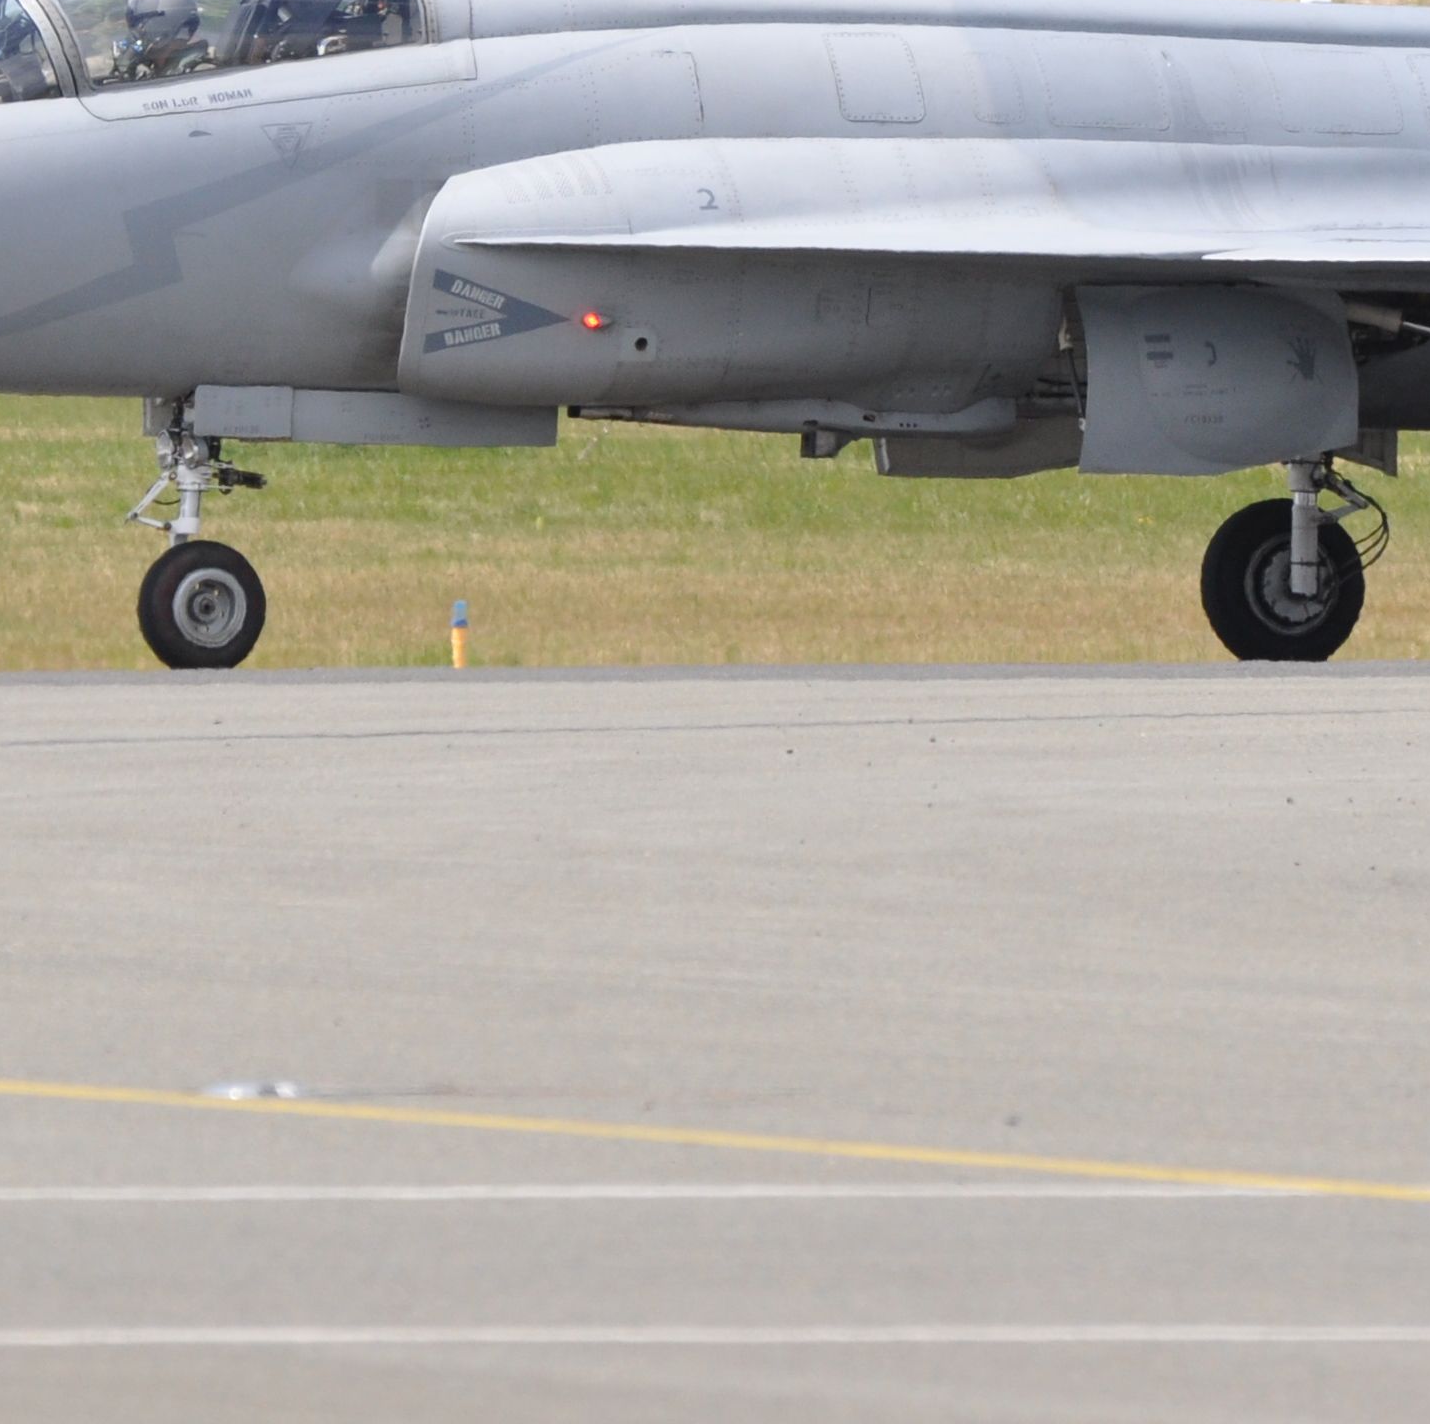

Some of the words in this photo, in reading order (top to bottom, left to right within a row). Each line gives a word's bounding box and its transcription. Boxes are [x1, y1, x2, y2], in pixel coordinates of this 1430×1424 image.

[697, 188, 719, 211] 2
[450, 279, 506, 309] DANGER
[444, 321, 502, 346] DANGER
